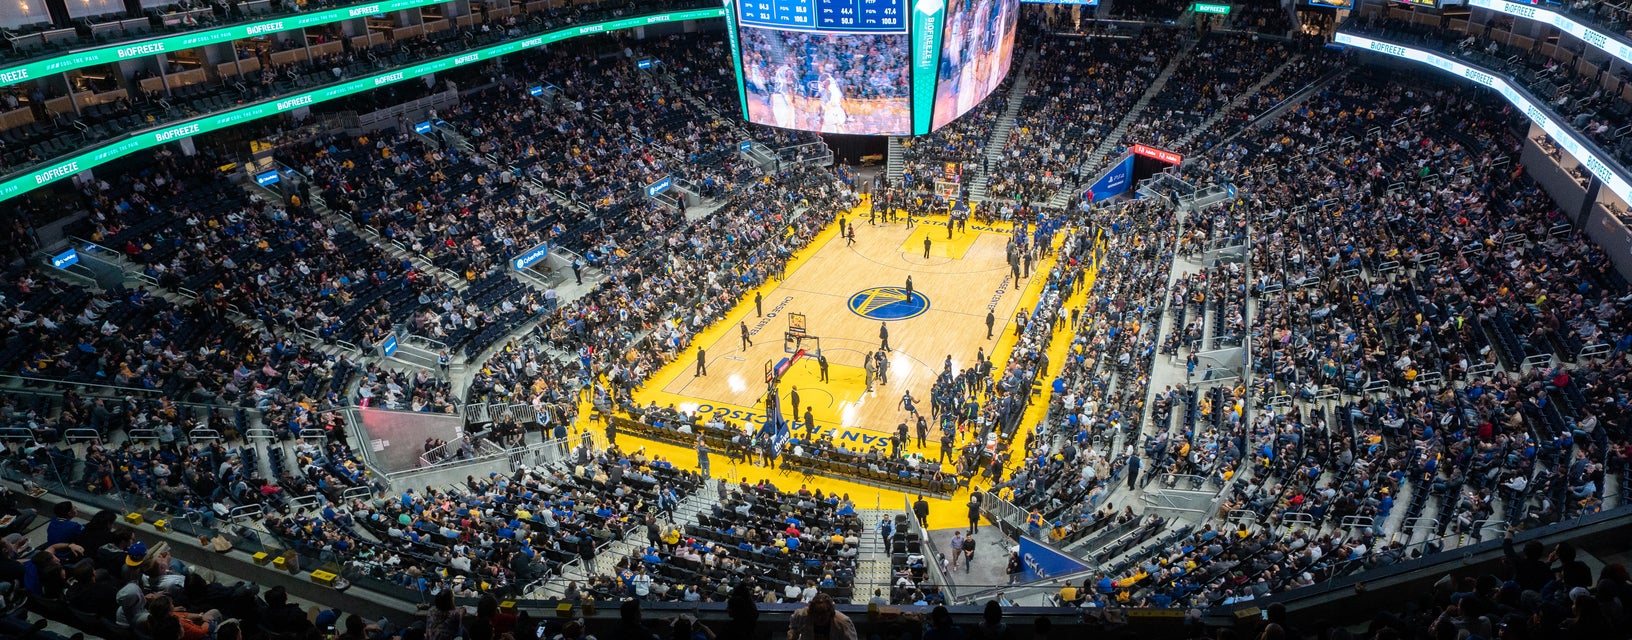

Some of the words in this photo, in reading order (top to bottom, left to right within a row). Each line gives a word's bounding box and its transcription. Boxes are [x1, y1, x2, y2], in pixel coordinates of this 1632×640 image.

[840, 7, 853, 15] 44.4
[841, 17, 854, 25] 50.0
[697, 404, 837, 437] FACISCO
[841, 431, 890, 447] SAN
[1024, 552, 1051, 579] CHA
